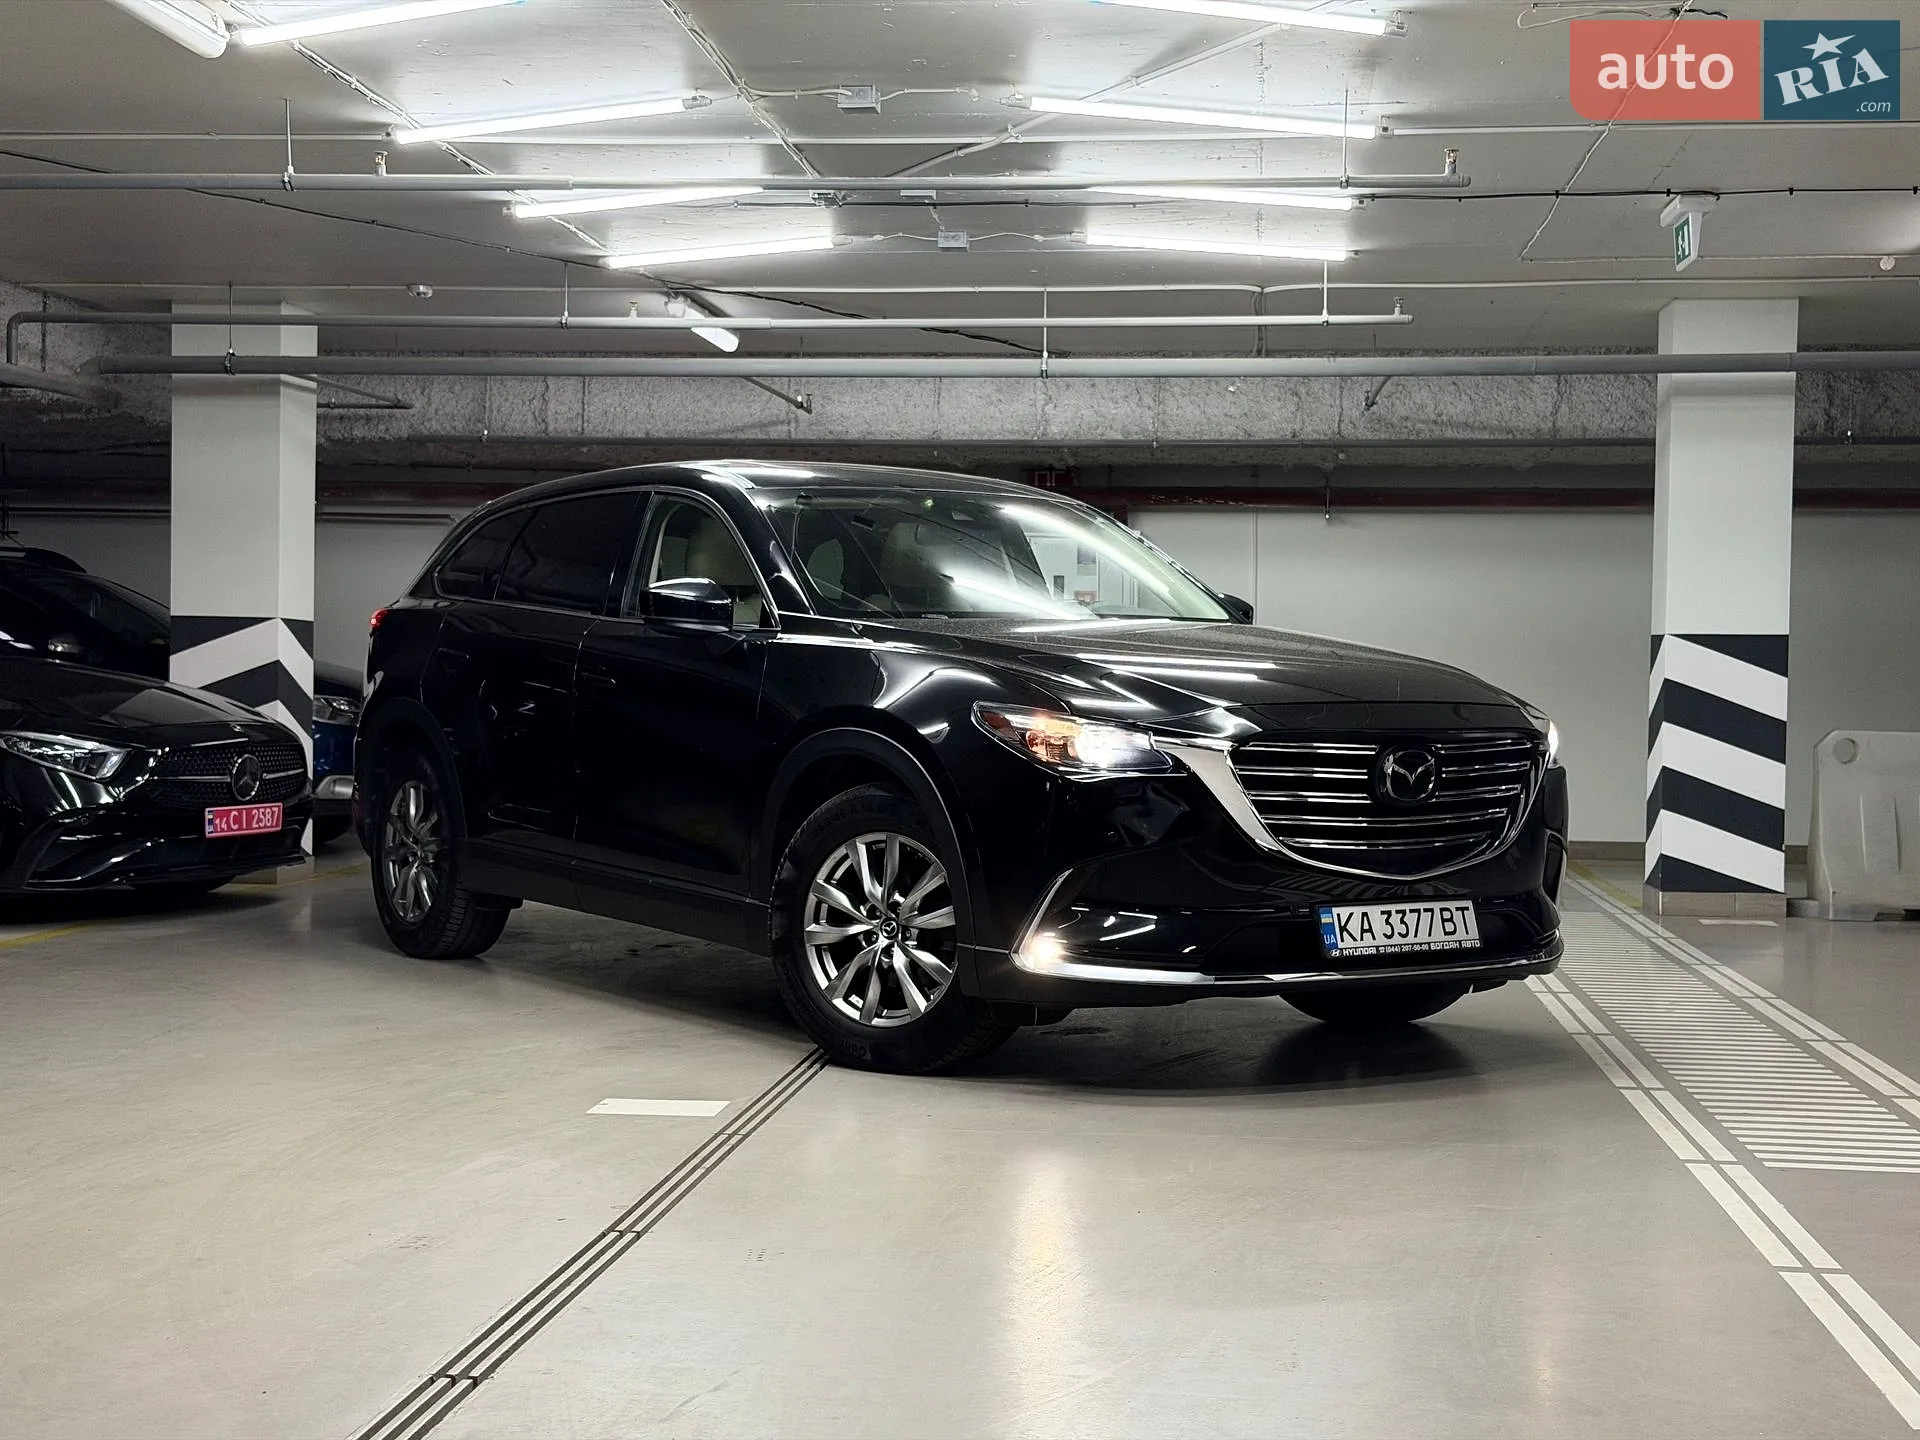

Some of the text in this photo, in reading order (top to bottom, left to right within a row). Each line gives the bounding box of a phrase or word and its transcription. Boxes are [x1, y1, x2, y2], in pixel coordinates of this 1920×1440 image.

[214, 817, 227, 831] 14
[252, 807, 279, 828] 2587
[1336, 906, 1470, 943] KA 3377 BT
[1324, 934, 1337, 945] UA
[1342, 947, 1377, 956] HYUNDAI
